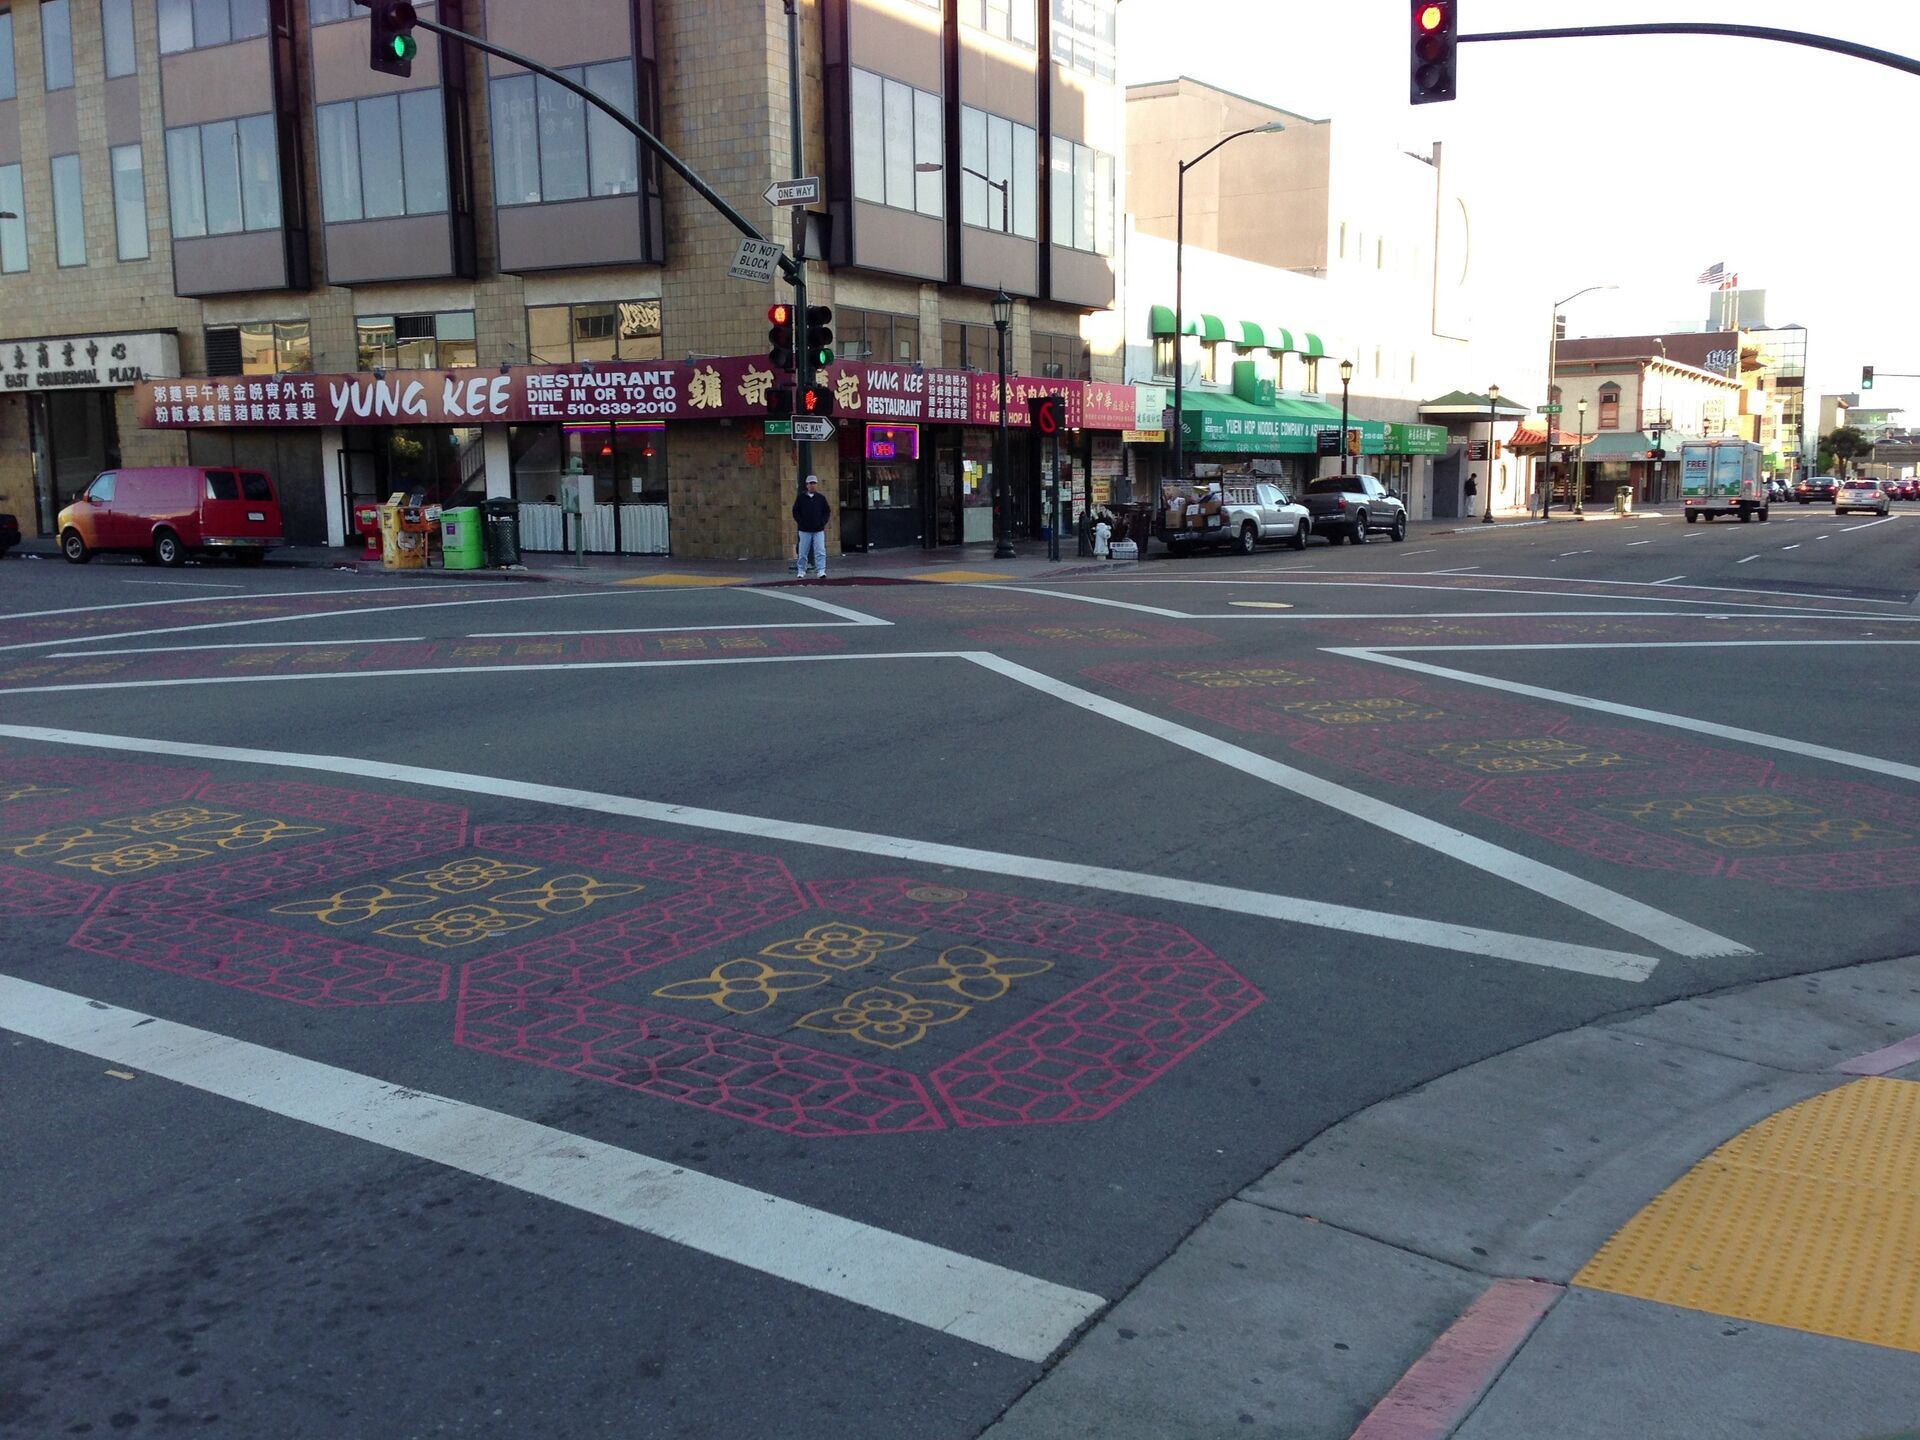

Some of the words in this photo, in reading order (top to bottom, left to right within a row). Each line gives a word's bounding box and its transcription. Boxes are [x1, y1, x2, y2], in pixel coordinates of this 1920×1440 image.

[778, 188, 793, 199] ONE
[795, 186, 813, 198] WAY
[743, 241, 756, 253] DO
[760, 244, 778, 257] NOT
[739, 255, 770, 270] BLOCK
[730, 266, 770, 280] INTERSECTION
[5, 372, 29, 388] EAST
[36, 368, 100, 387] COMMERCIAL
[108, 366, 143, 383] PLAZA
[526, 370, 675, 389] RESTAURANT
[866, 369, 899, 392] YUNG
[904, 373, 924, 393] KEE
[329, 379, 428, 421] YUNG
[443, 376, 512, 417] KEE
[527, 389, 563, 402] DINE
[570, 389, 586, 401] IN
[594, 388, 616, 401] OR
[624, 387, 645, 400] TO
[653, 386, 676, 400] GO
[528, 403, 563, 416] TEL.
[866, 396, 922, 418] RESTAURANT
[990, 411, 1000, 423] NE
[1008, 412, 1022, 424] HOP
[796, 423, 809, 433] ONE
[810, 424, 823, 433] WAY
[1225, 419, 1242, 435] YUEN
[1244, 420, 1256, 435] HOP
[1257, 421, 1279, 436] NOODLE
[1280, 422, 1304, 437] COMPANY
[875, 443, 894, 455] OPEN
[1686, 460, 1708, 468] FREE
